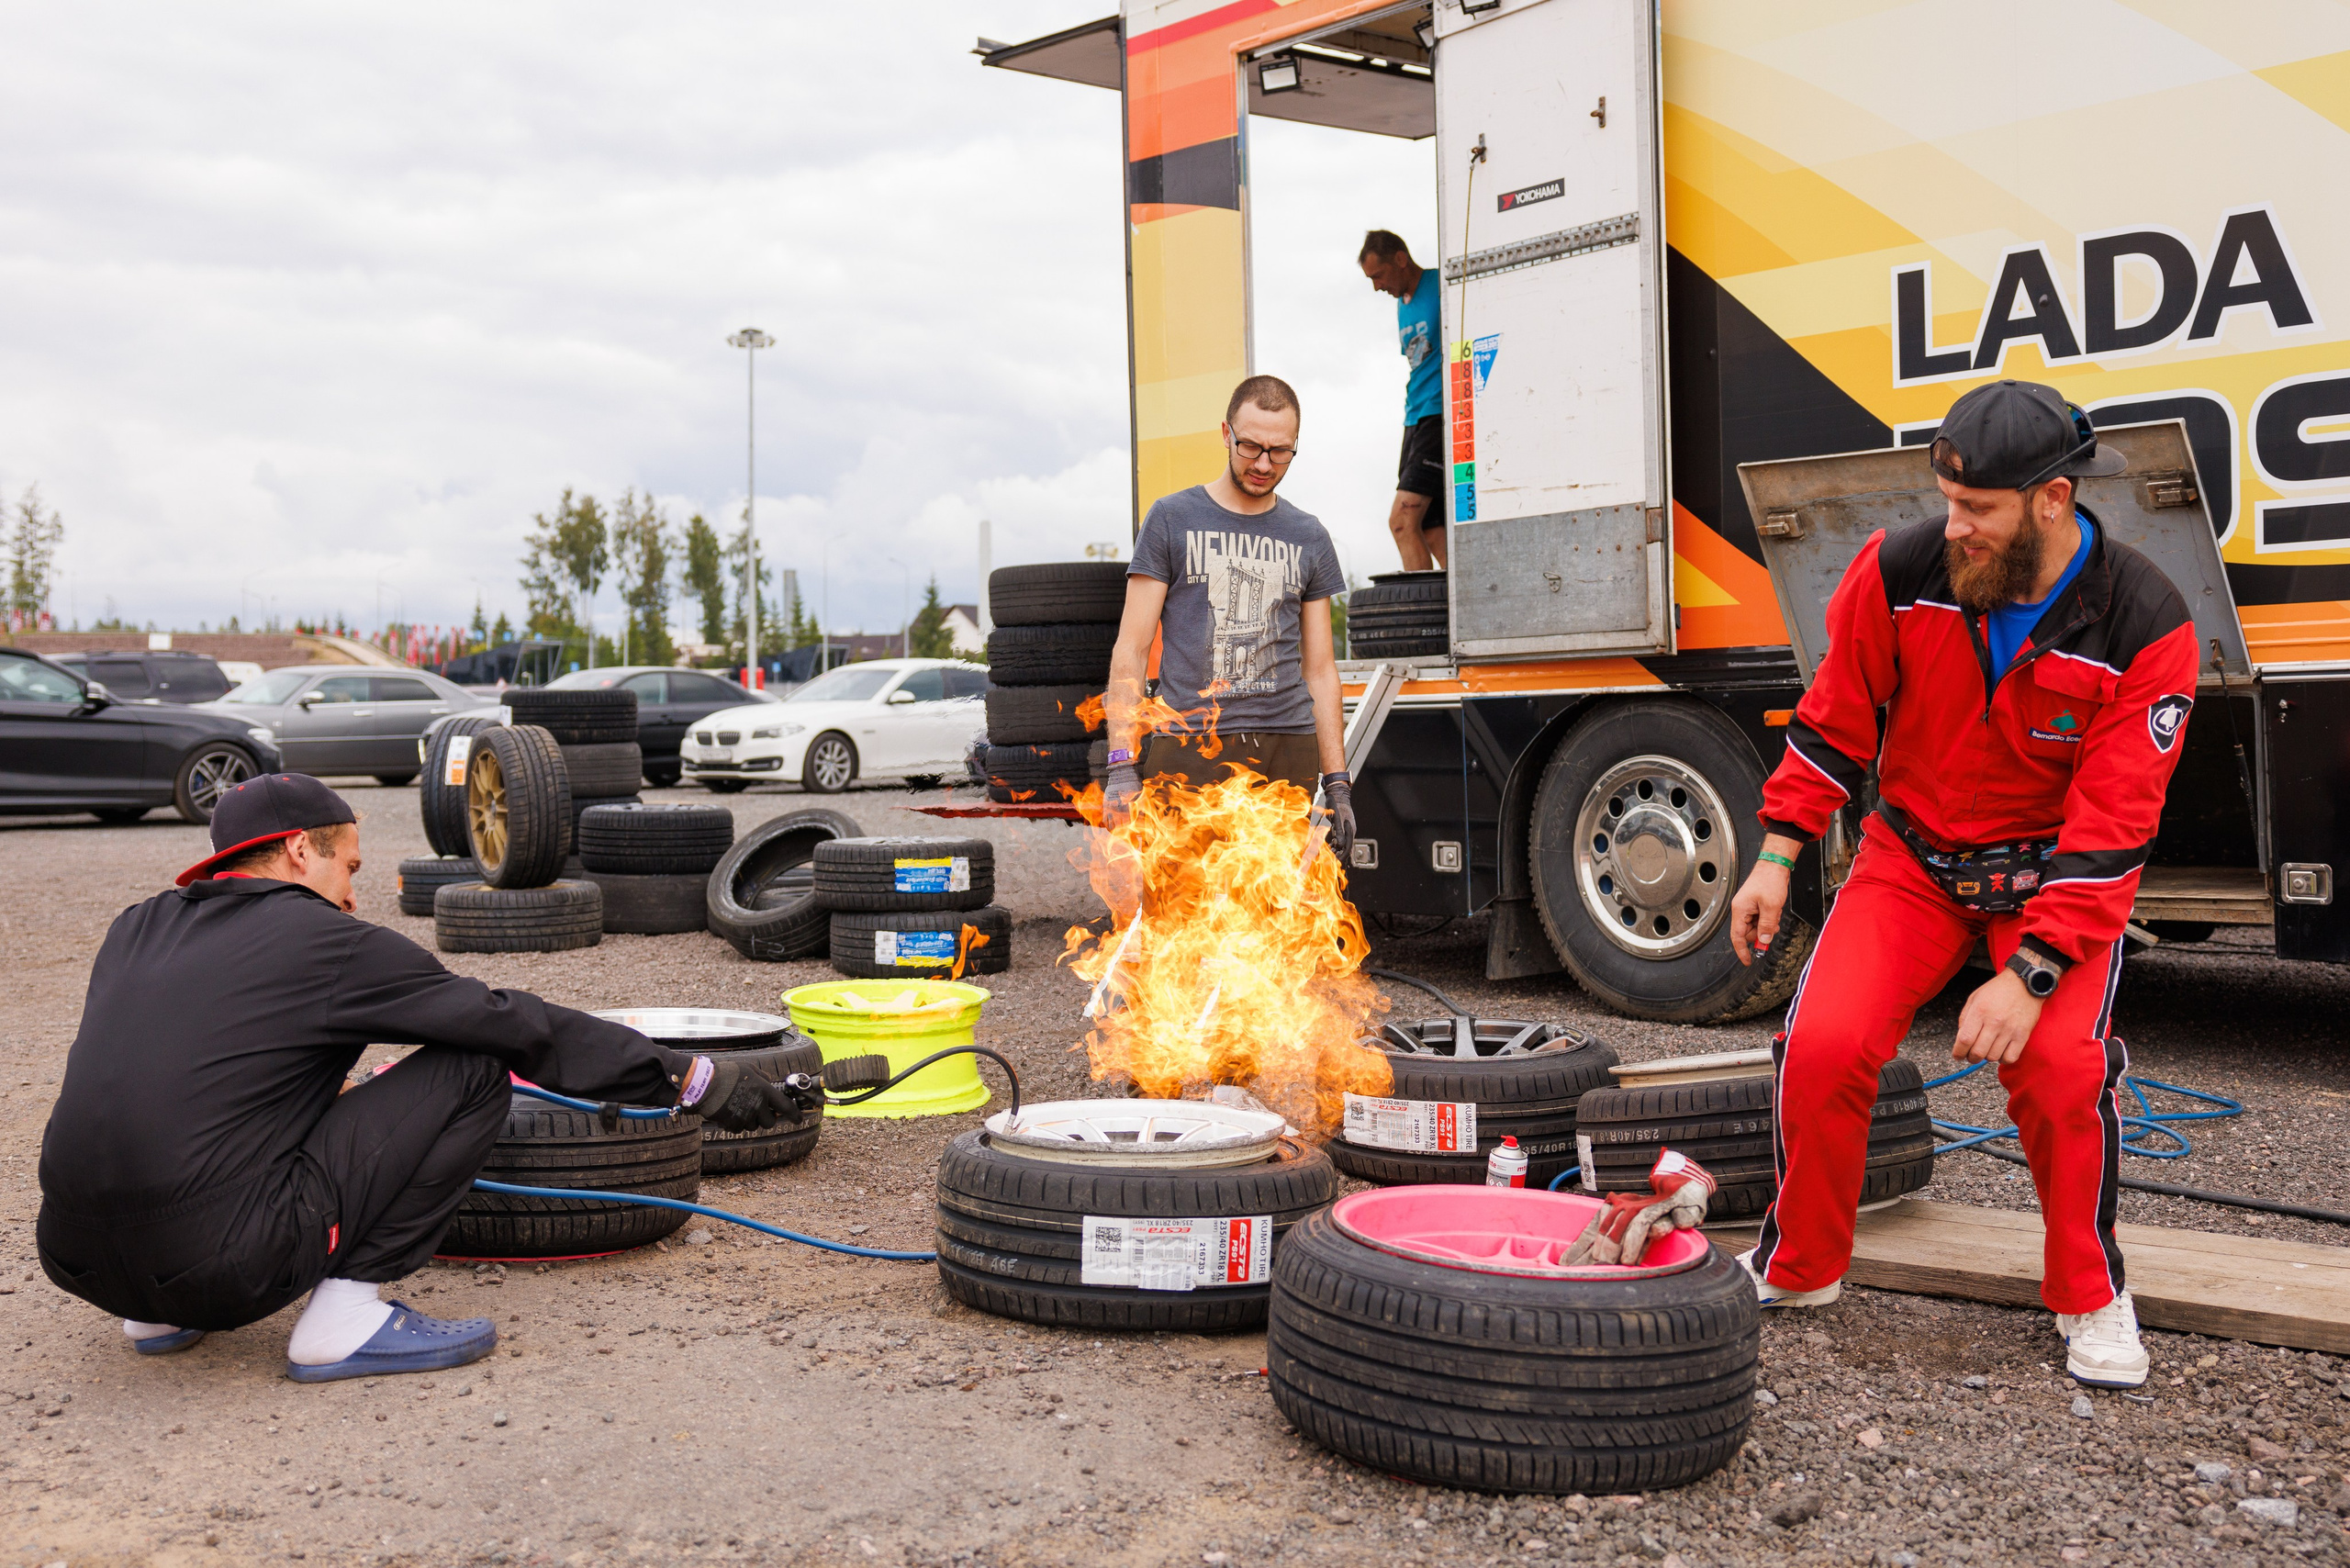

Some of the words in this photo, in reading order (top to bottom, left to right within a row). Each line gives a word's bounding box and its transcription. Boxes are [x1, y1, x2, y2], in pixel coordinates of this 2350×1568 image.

[1515, 183, 1561, 204] YOKOHAMA
[1894, 204, 2319, 386] LADA
[1462, 342, 1472, 358] 6
[1463, 363, 1472, 378] 8
[1464, 382, 1472, 398] 8
[1464, 402, 1472, 419] 3
[1465, 423, 1472, 439] 3
[1465, 443, 1472, 459] 3
[1465, 464, 1474, 480] 4
[1467, 485, 1475, 500] 5
[1468, 504, 1475, 520] 5
[1187, 576, 1199, 584] CITY
[1200, 575, 1208, 583] OF
[2031, 730, 2065, 741] Bernardo
[1429, 1141, 1436, 1149] XL
[1219, 1220, 1227, 1249] 235/40
[1259, 1219, 1268, 1256] KUMHO
[1198, 1242, 1206, 1275] 2167333
[1217, 1250, 1226, 1271] ZR18
[1259, 1257, 1267, 1279] TIRE
[1216, 1271, 1225, 1282] XL
